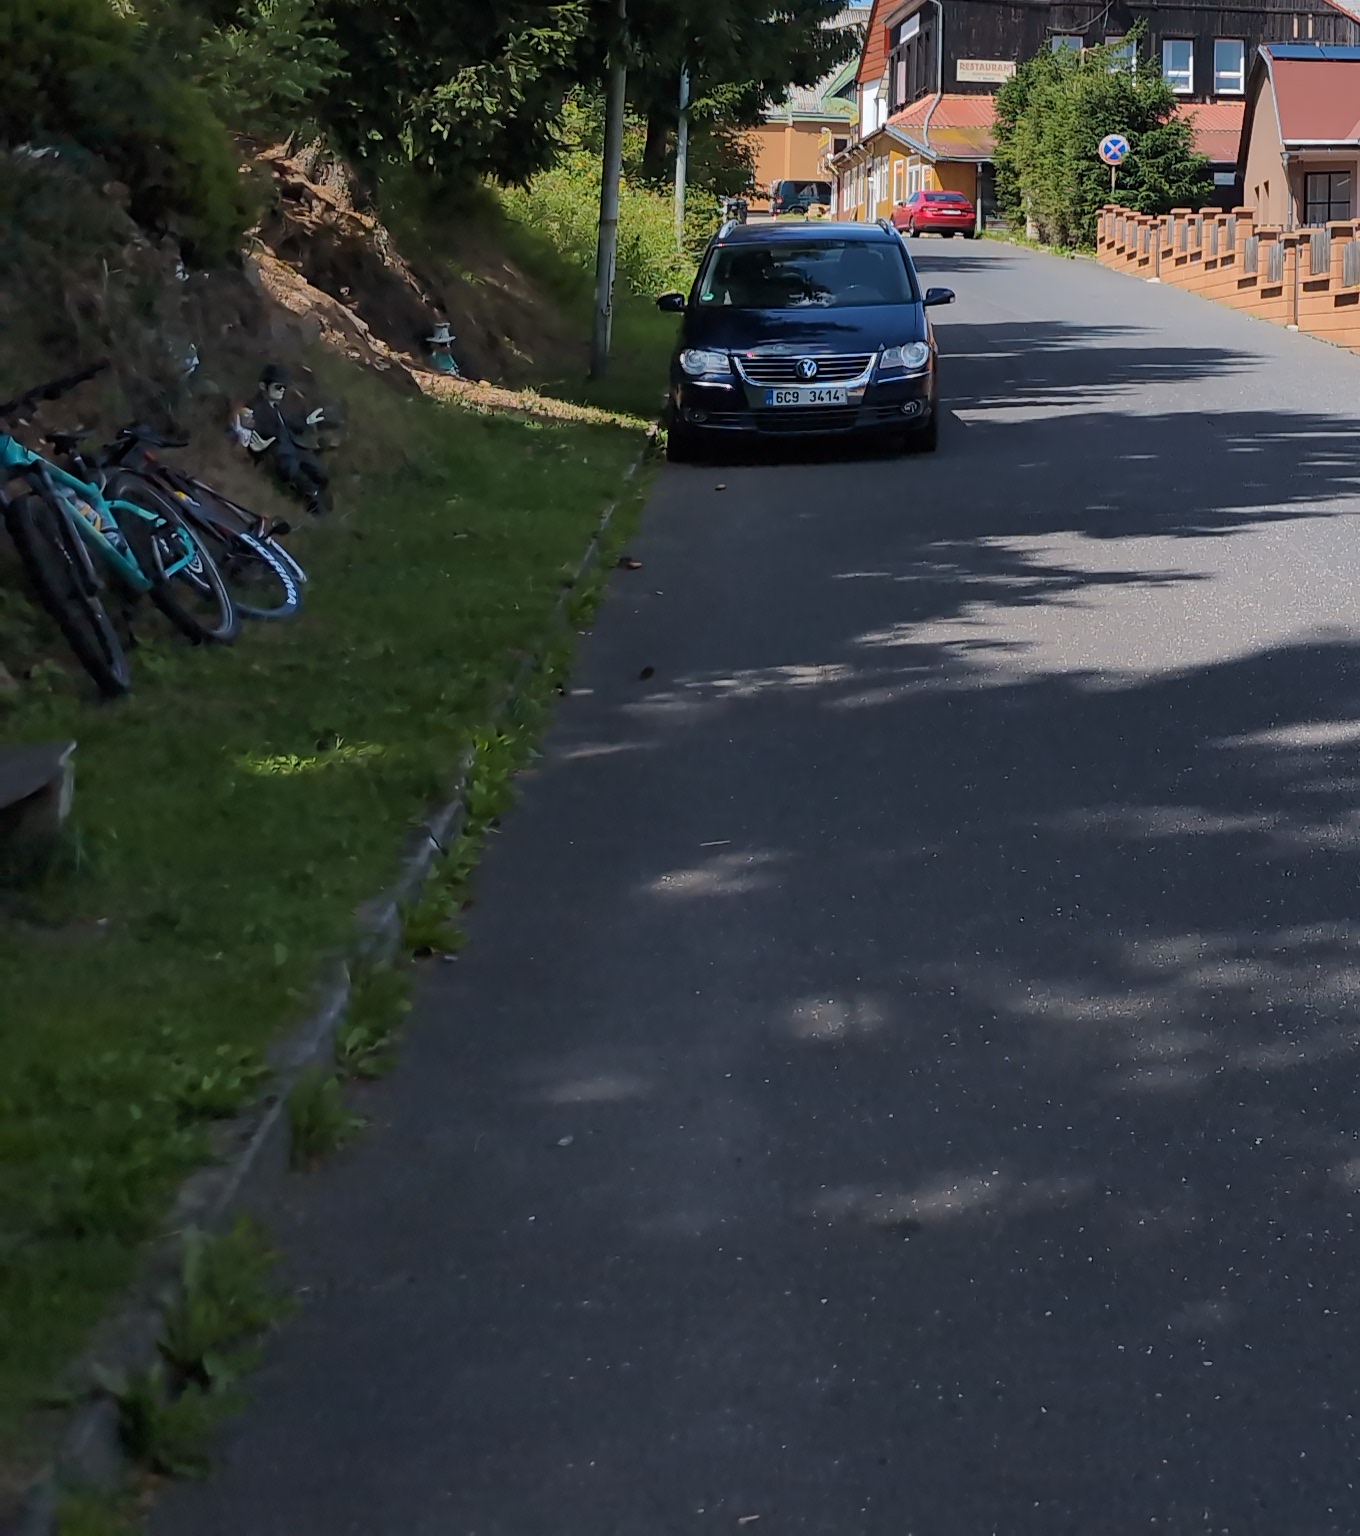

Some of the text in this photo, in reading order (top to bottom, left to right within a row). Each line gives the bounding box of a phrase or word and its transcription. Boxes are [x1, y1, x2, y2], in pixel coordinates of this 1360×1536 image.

[776, 390, 840, 403] 6C9 3414
[240, 533, 297, 605] CORIMA
